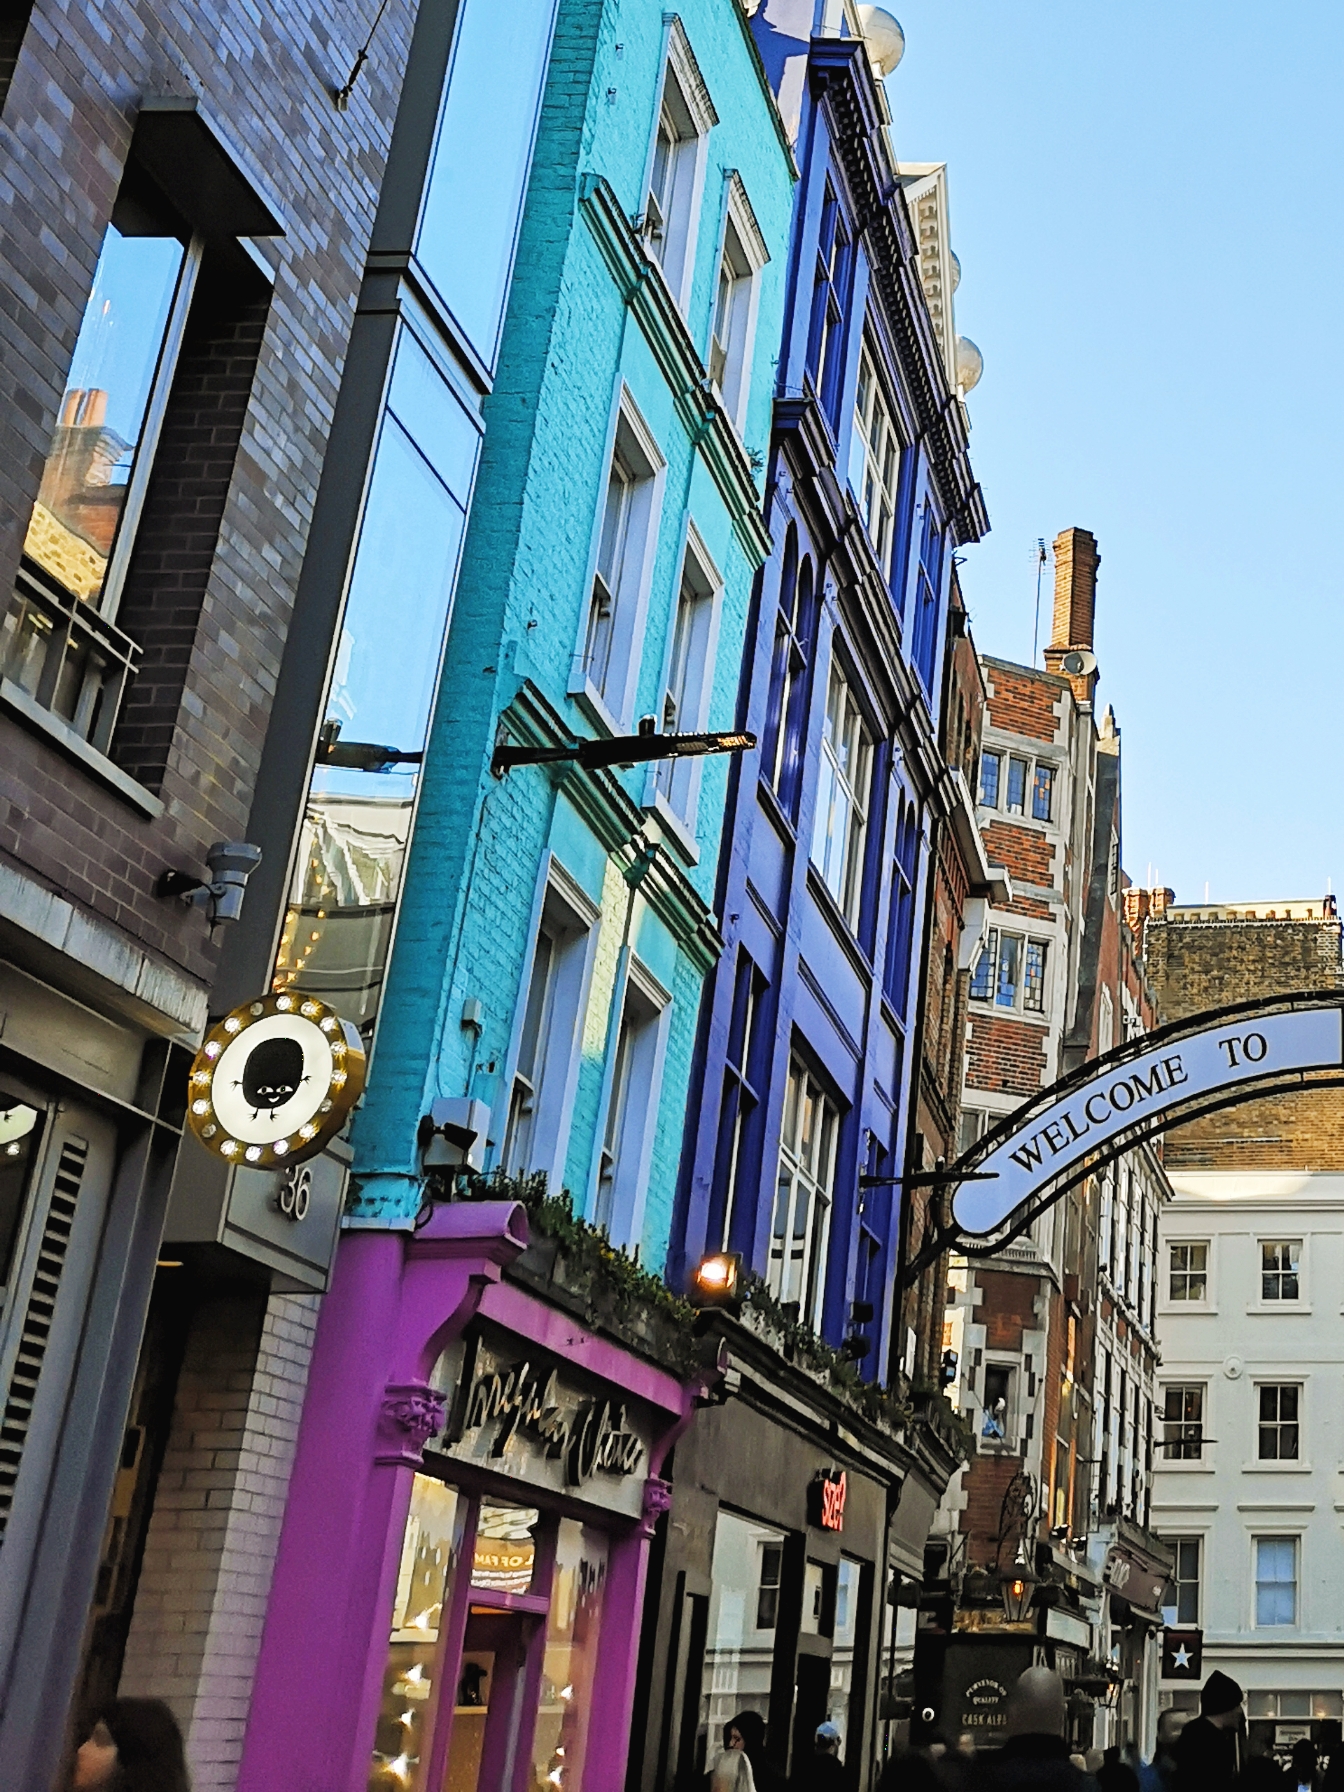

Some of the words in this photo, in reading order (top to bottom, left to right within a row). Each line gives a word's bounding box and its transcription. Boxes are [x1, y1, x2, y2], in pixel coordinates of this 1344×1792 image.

[1008, 1055, 1188, 1173] WELCOME
[1218, 1032, 1268, 1069] TO
[280, 1164, 313, 1221] 36
